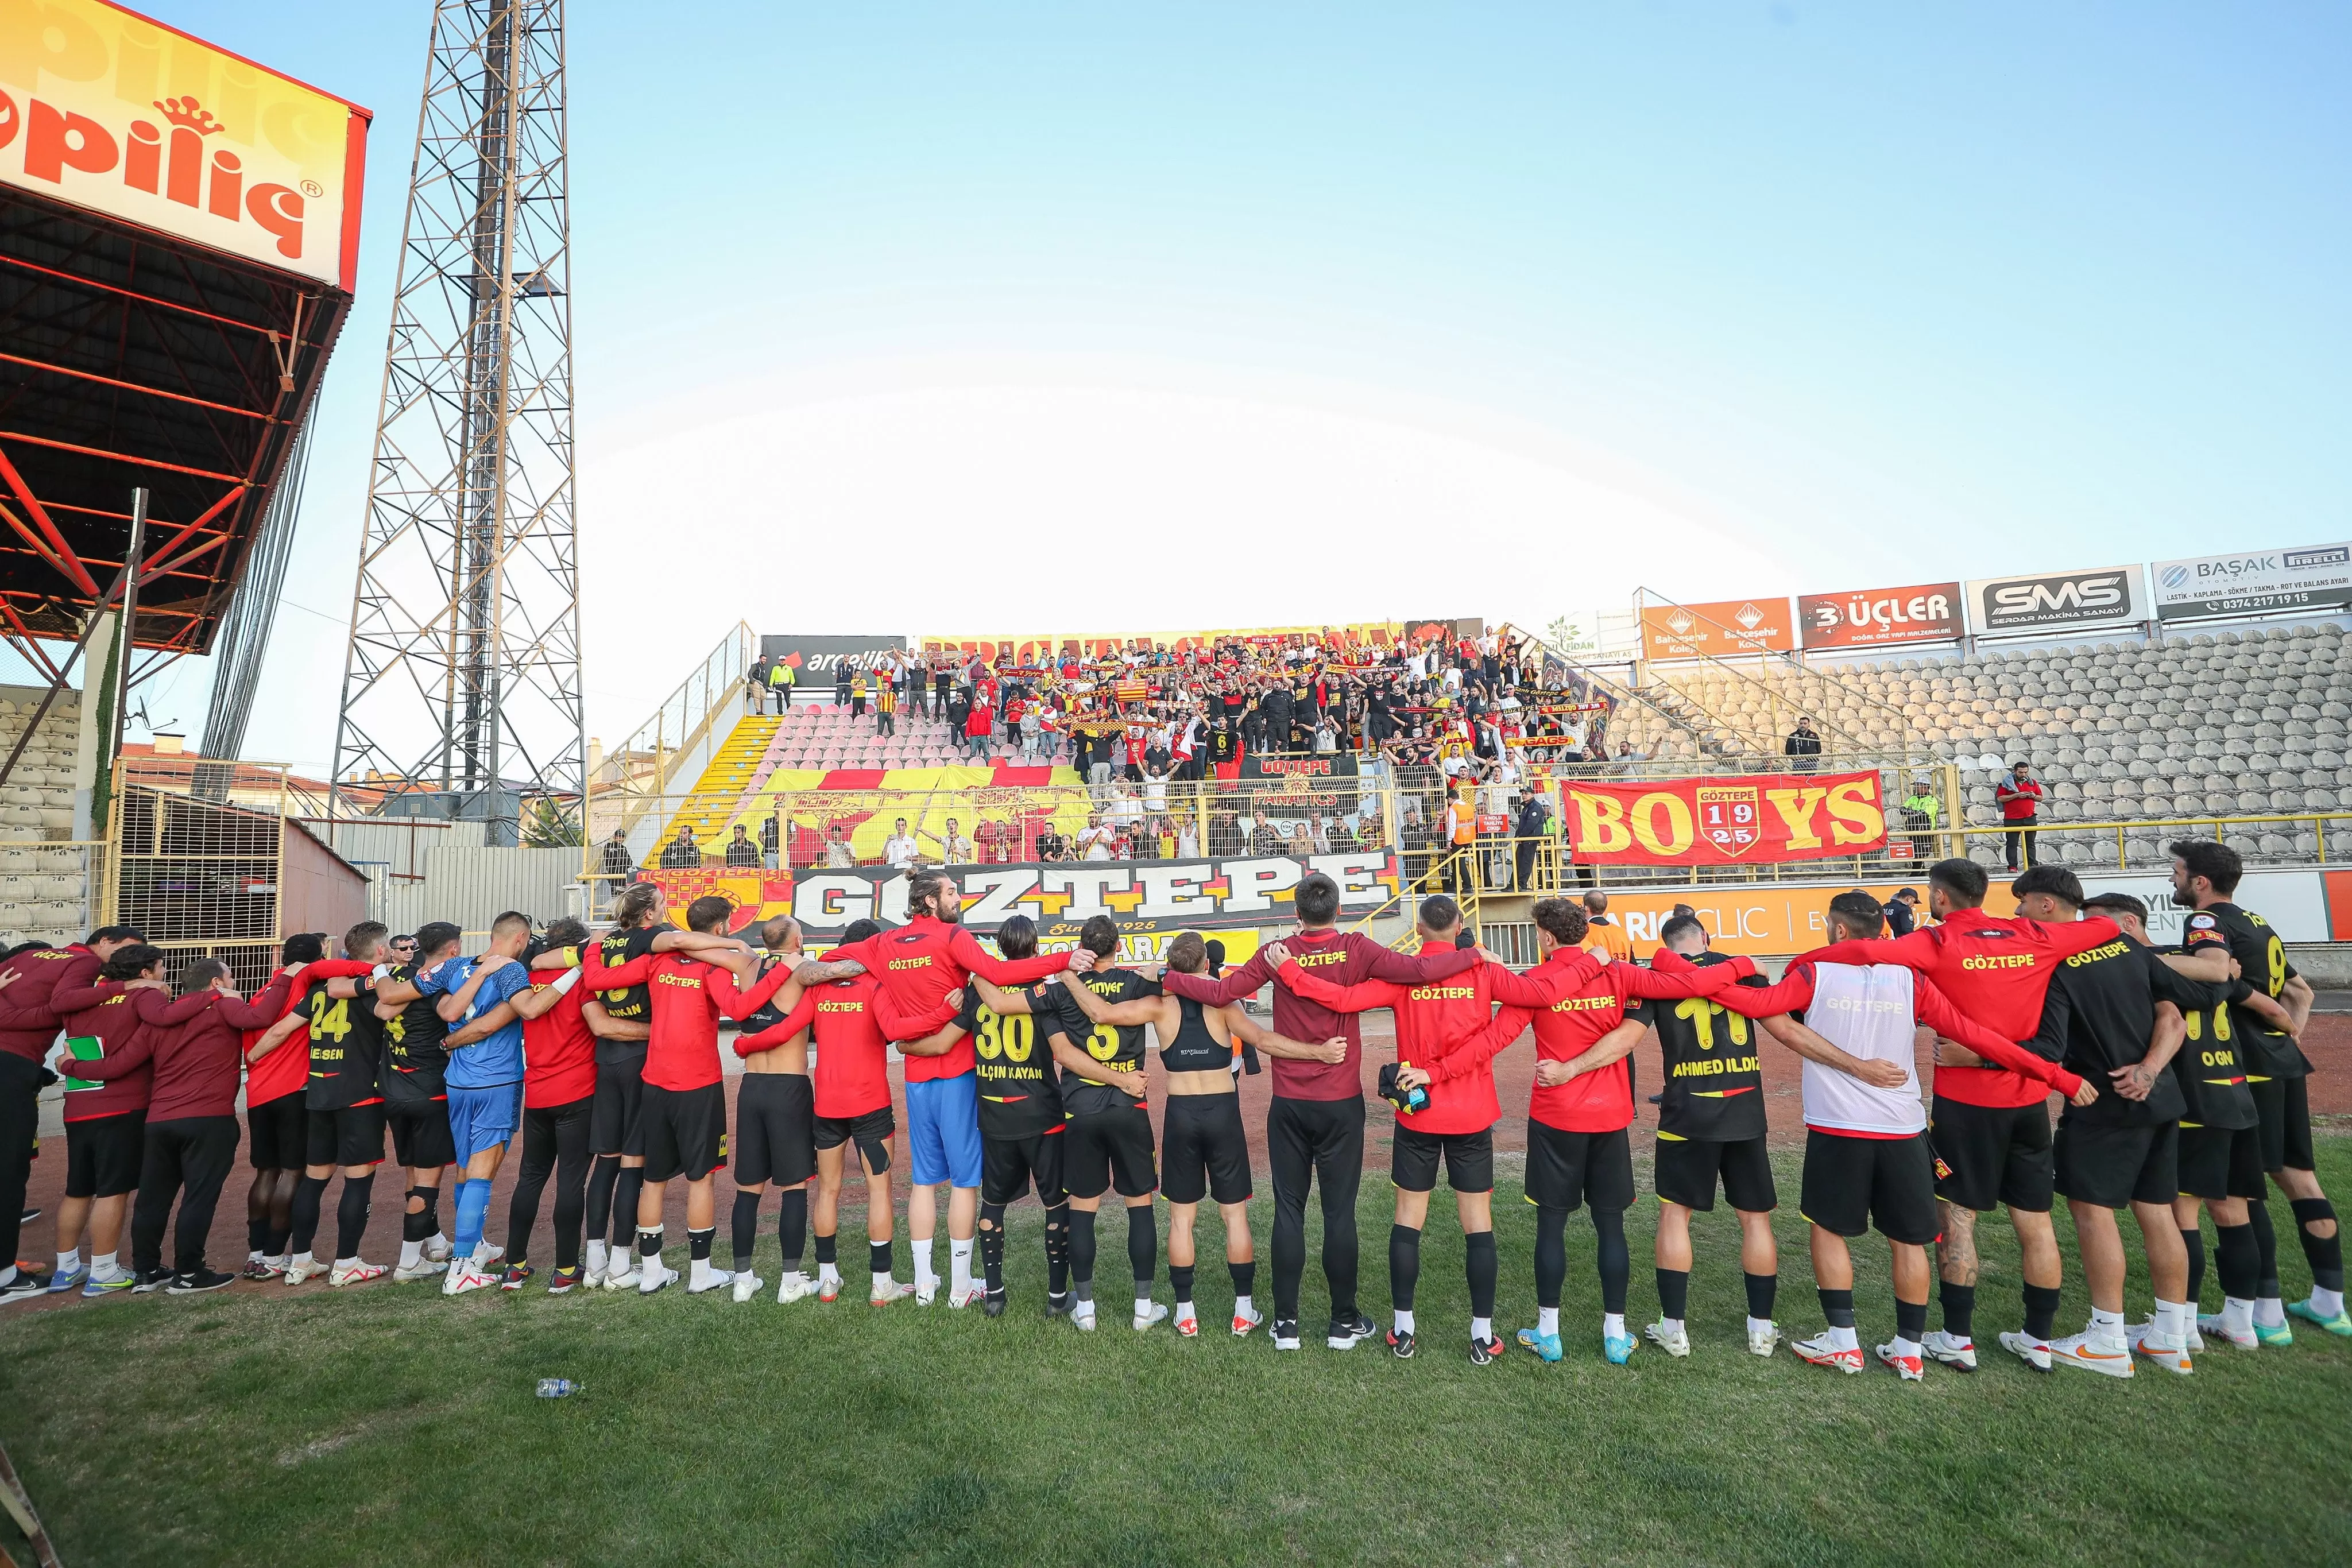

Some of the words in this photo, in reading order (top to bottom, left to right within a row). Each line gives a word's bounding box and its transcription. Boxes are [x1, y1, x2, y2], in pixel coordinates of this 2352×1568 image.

[2198, 556, 2277, 577] BAŞAK
[2288, 550, 2345, 567] PIRELLI
[1991, 576, 2121, 615] SMS
[2167, 592, 2187, 601] LASTİK
[2194, 590, 2223, 599] KAPLAMA
[2227, 586, 2249, 595] SÖKME
[2280, 582, 2293, 590] ROT
[2294, 581, 2303, 589] VE
[2304, 579, 2329, 588] BALANS
[2330, 576, 2349, 585] AYARI
[2223, 599, 2251, 609] 0374
[2254, 597, 2274, 606] 217
[2277, 594, 2292, 605] 19
[2295, 593, 2308, 603] 15
[1848, 594, 1949, 632] ÜÇLER
[1992, 616, 2035, 625] SERDAR
[2038, 611, 2080, 621] MAKİNA
[2083, 606, 2123, 617] SANAYİ
[1724, 628, 1778, 639] Bahçeşehir
[1852, 632, 1875, 641] DOĞAL
[1908, 626, 1951, 637] MALZEMELERİ
[1566, 641, 1595, 651] FİDAN
[1669, 642, 1696, 655] Koleji
[1738, 638, 1766, 649] Koleji
[1552, 704, 1577, 713] GÖZTEPE
[1217, 735, 1227, 749] 6
[1261, 759, 1332, 775] GÖZTEPE
[1700, 788, 1755, 802] GÖZTEPE
[1292, 950, 1347, 968] GÖZTEPE
[1962, 953, 2035, 971] GÖZTEPE
[2067, 940, 2131, 968] GÖZTEPE
[888, 955, 933, 971] GÖZTEPE
[2267, 935, 2287, 998] 9
[658, 972, 701, 989] GÖZTEPE
[1411, 985, 1475, 1001] GÖZTEPE
[818, 999, 864, 1013] GÖZTEPE
[1551, 995, 1617, 1013] GÖZTEPE
[1827, 996, 1904, 1015] GÖZTEPE
[310, 991, 352, 1043] 24
[976, 1002, 1034, 1062] 30
[976, 1064, 1007, 1082] ALÇIN
[1008, 1066, 1043, 1080] KAYAN
[1673, 1058, 1724, 1078] AHMED
